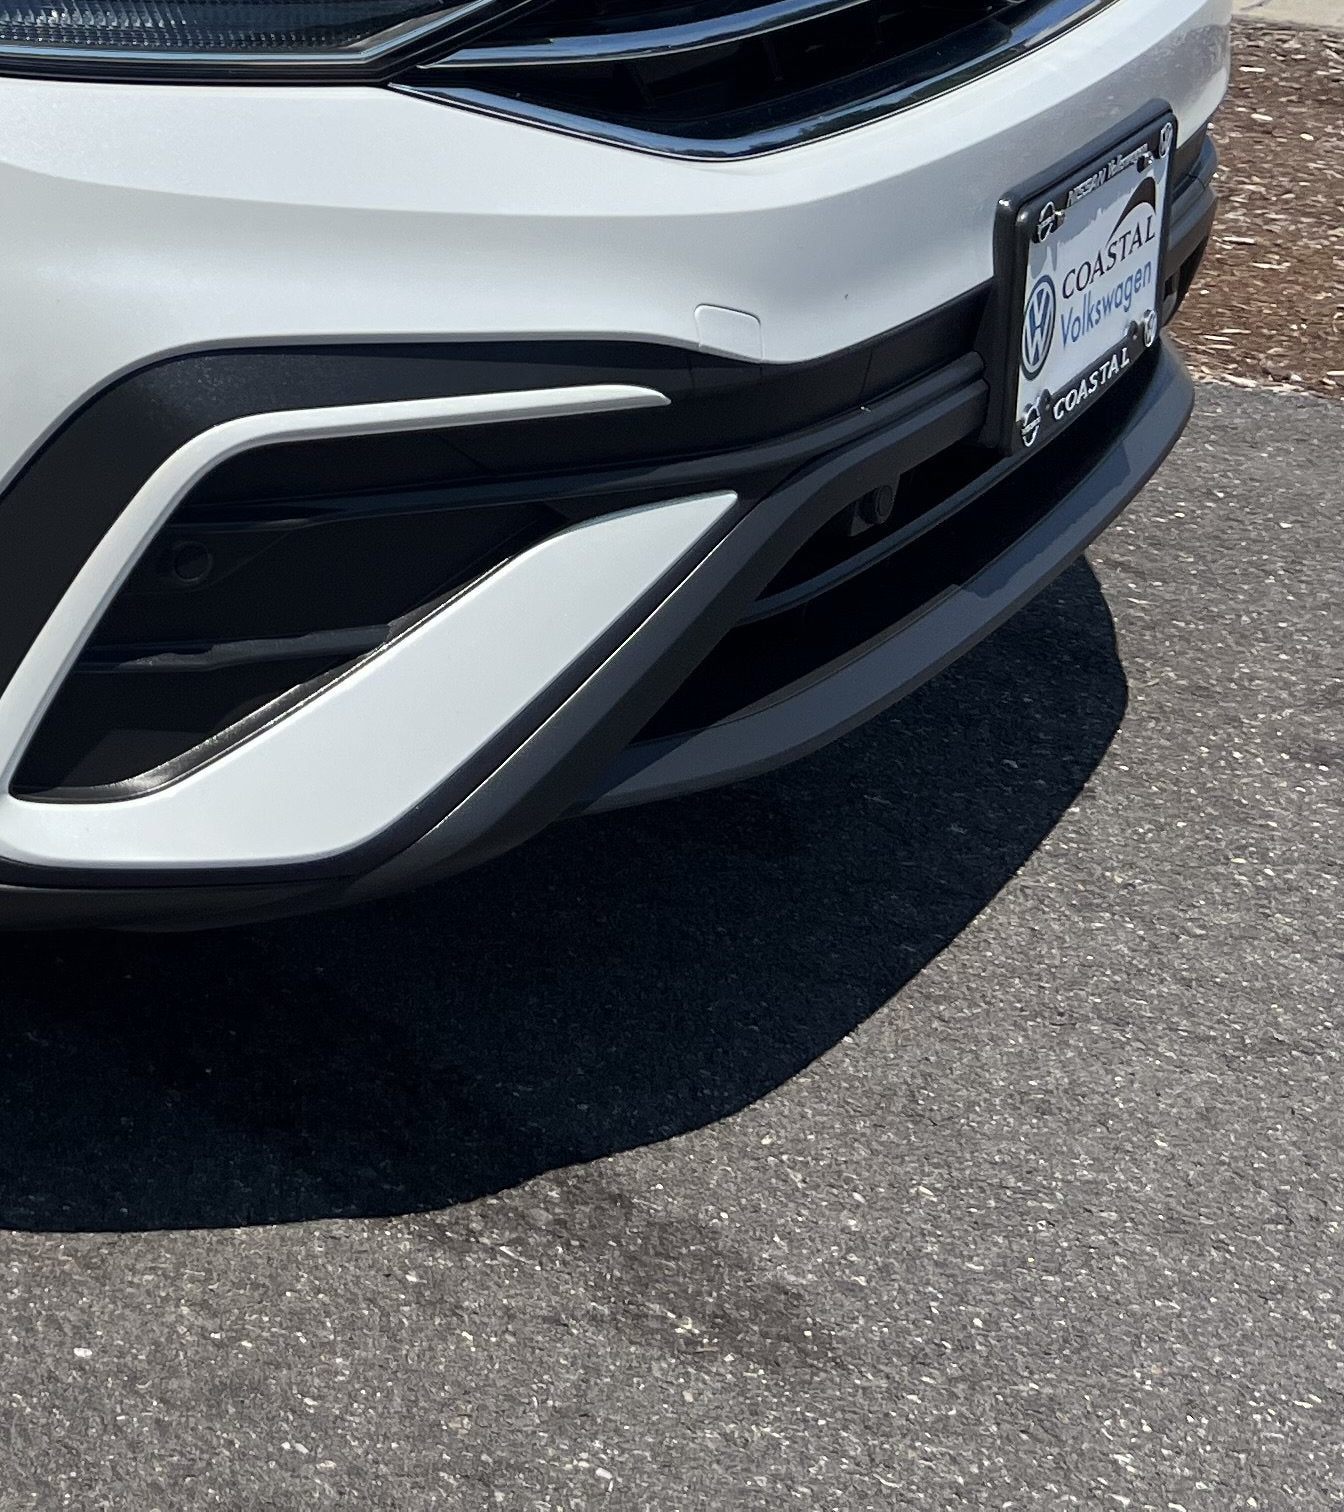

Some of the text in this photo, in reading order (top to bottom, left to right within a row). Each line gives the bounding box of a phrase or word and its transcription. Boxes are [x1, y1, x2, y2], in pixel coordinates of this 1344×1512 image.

[1062, 214, 1157, 300] COASTAL
[1023, 278, 1056, 378] VW
[1060, 261, 1153, 350] Volkswagen
[1053, 347, 1131, 420] COASTAL
